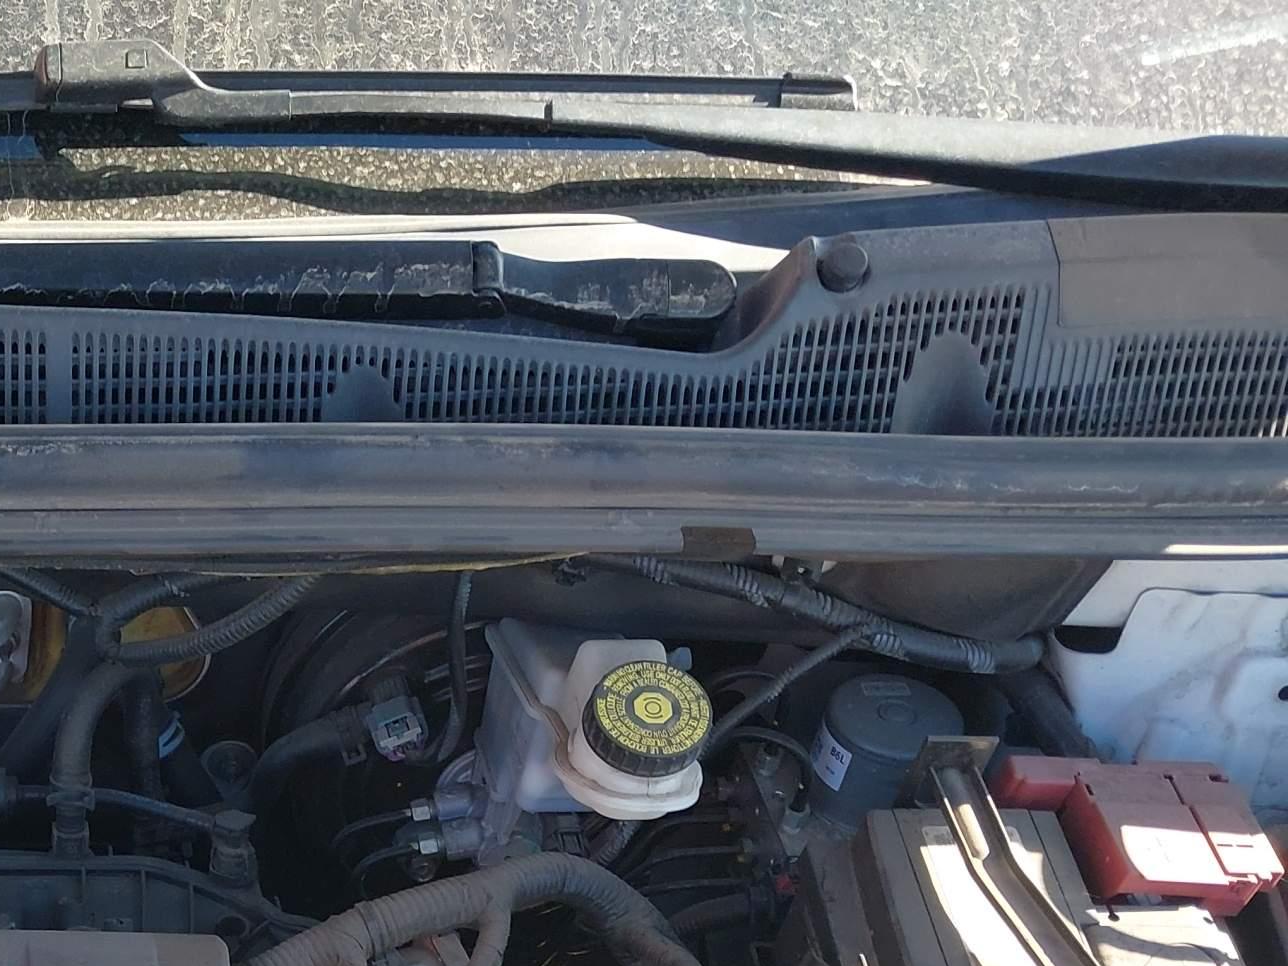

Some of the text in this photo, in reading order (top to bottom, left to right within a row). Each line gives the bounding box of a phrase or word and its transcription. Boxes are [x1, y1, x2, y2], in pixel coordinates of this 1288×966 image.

[643, 662, 666, 671] FILLER
[667, 667, 683, 677] CAP
[655, 671, 670, 681] ONLY
[650, 746, 659, 754] LE
